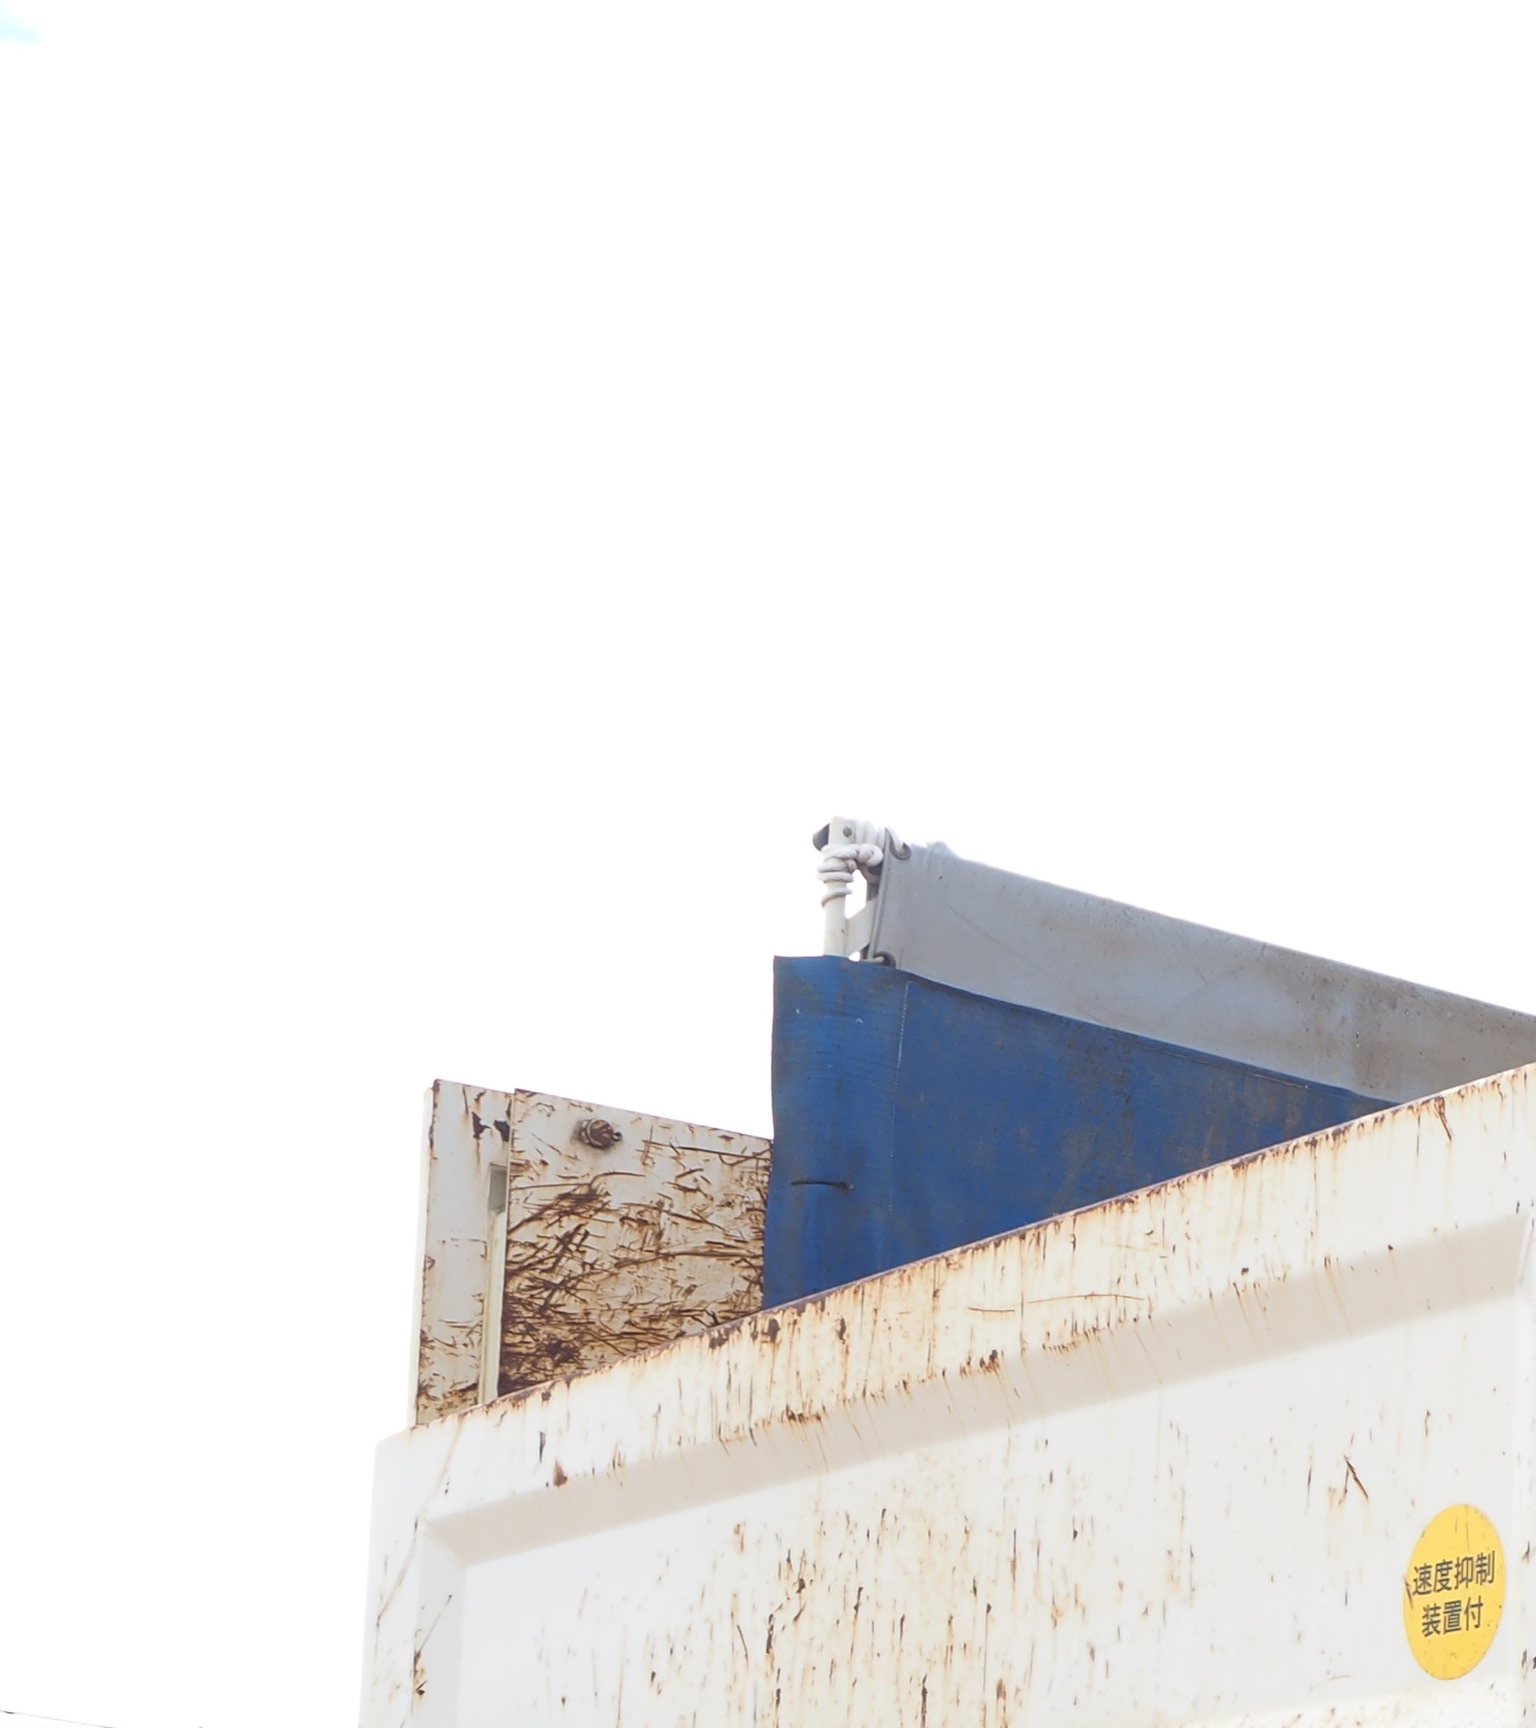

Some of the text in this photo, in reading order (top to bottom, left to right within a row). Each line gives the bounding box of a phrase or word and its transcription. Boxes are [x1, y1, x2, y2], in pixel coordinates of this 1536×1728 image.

[1412, 1550, 1495, 1596] 速度抑制
[1421, 1595, 1484, 1638] 装置付
